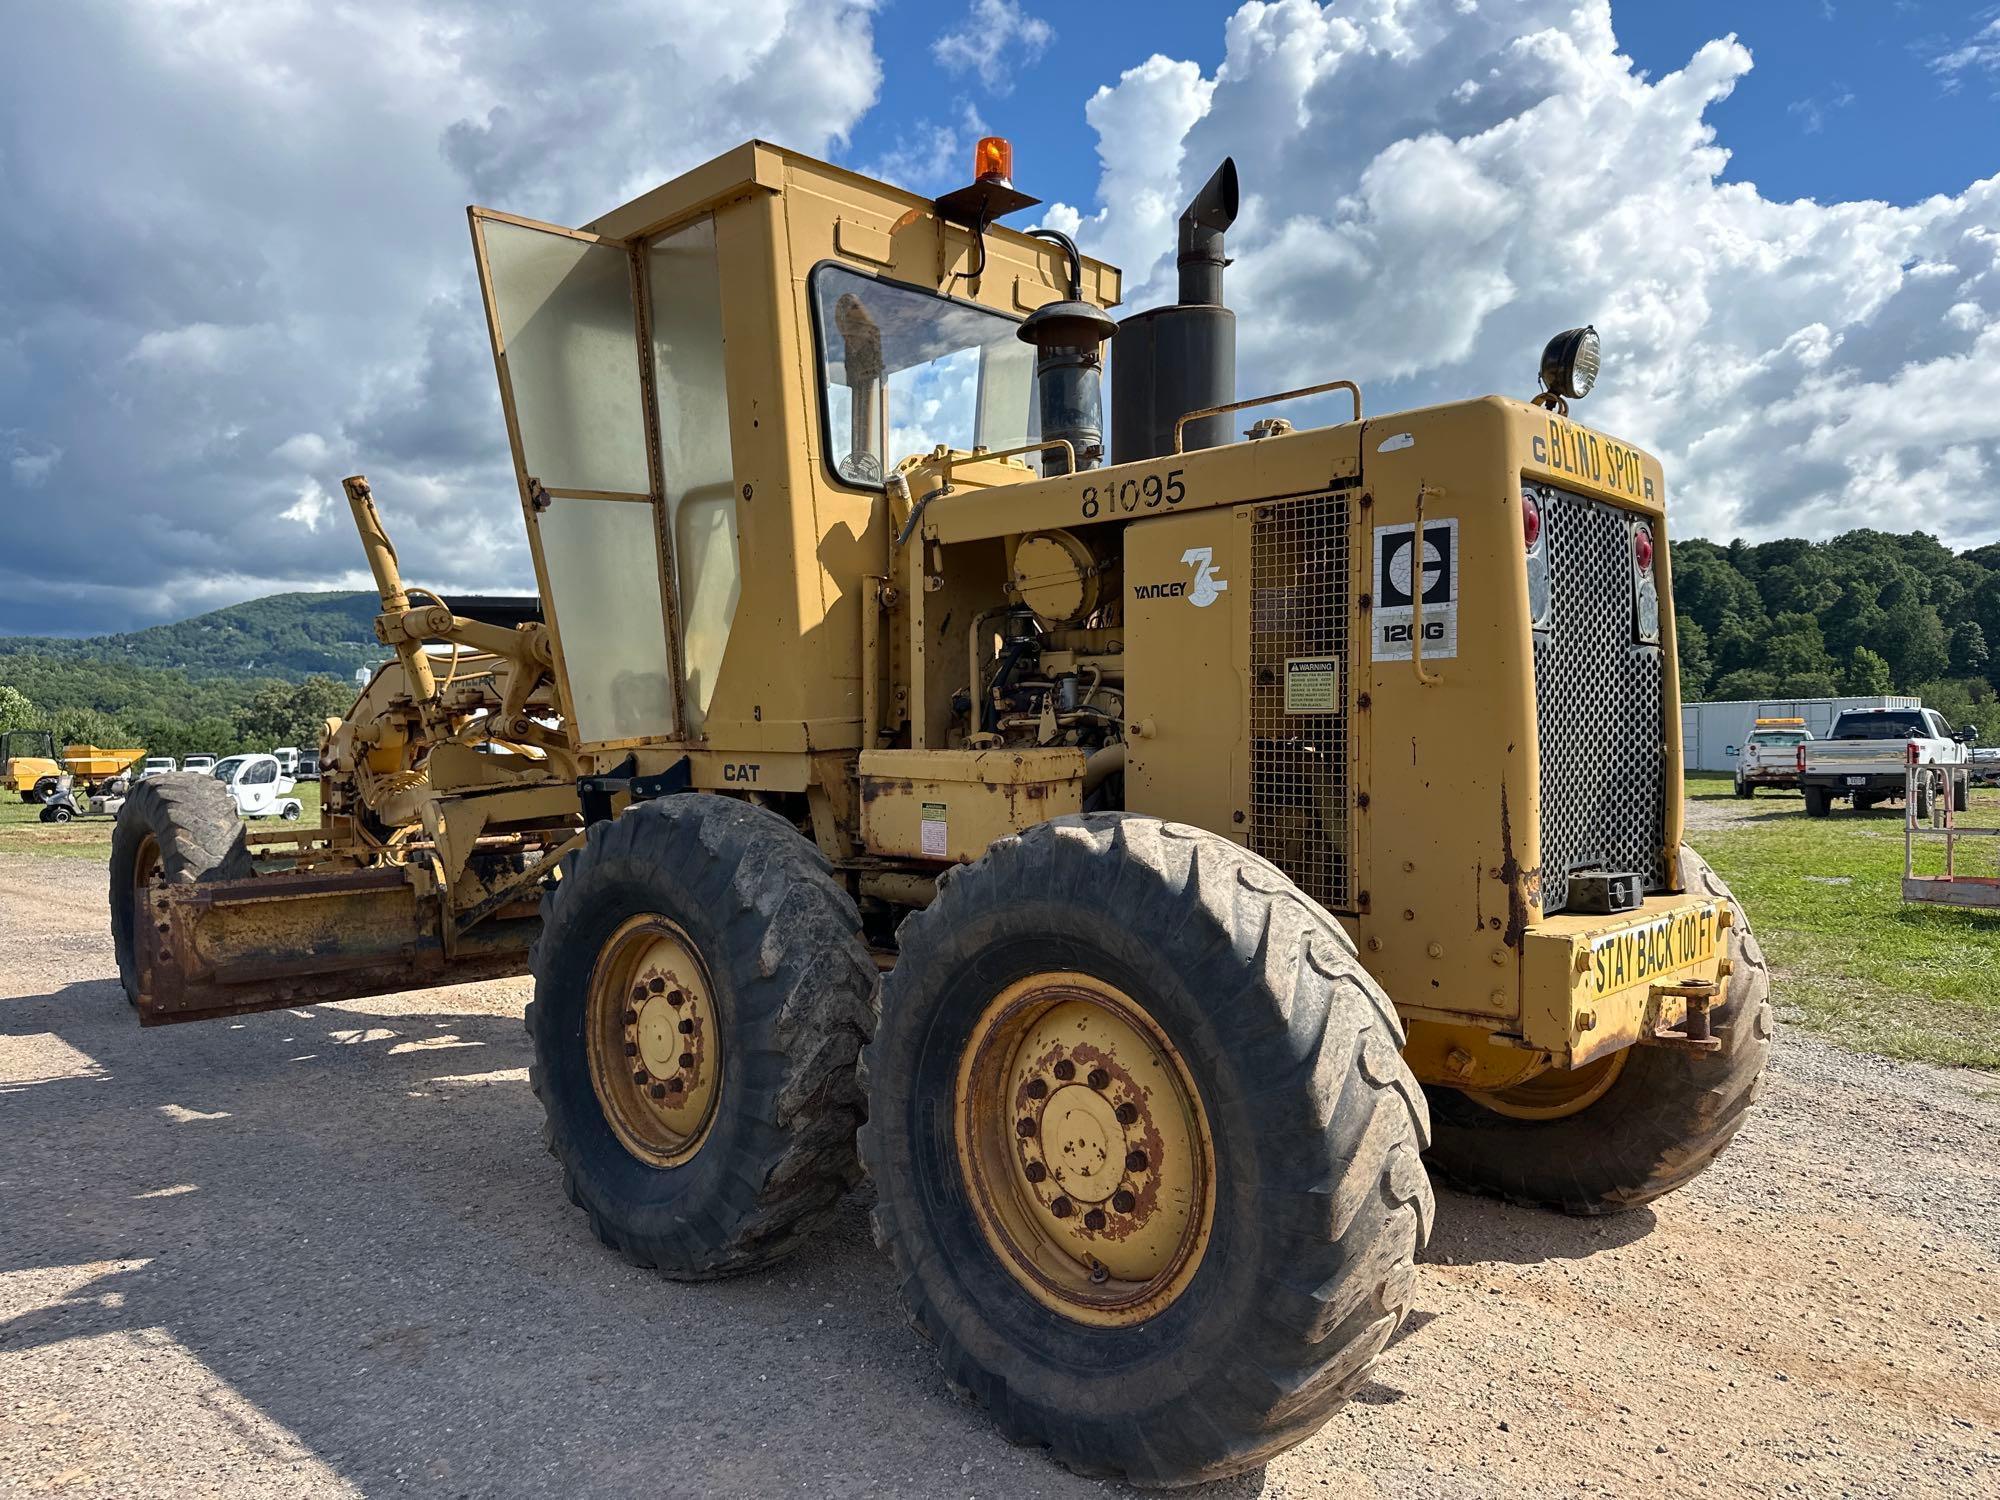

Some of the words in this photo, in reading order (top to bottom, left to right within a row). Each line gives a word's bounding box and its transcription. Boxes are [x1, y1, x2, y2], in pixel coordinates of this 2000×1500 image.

[1549, 419, 1601, 481] BLIND
[1605, 441, 1641, 497] SPOT
[1081, 469, 1186, 519] 81095
[1134, 581, 1188, 599] YANCEY
[1298, 663, 1332, 671] WARNING
[724, 764, 760, 782] CAT
[1596, 931, 1634, 993] STAY
[1637, 920, 1675, 979] BACK
[1677, 916, 1697, 963] 100
[1699, 909, 1714, 957] FT
